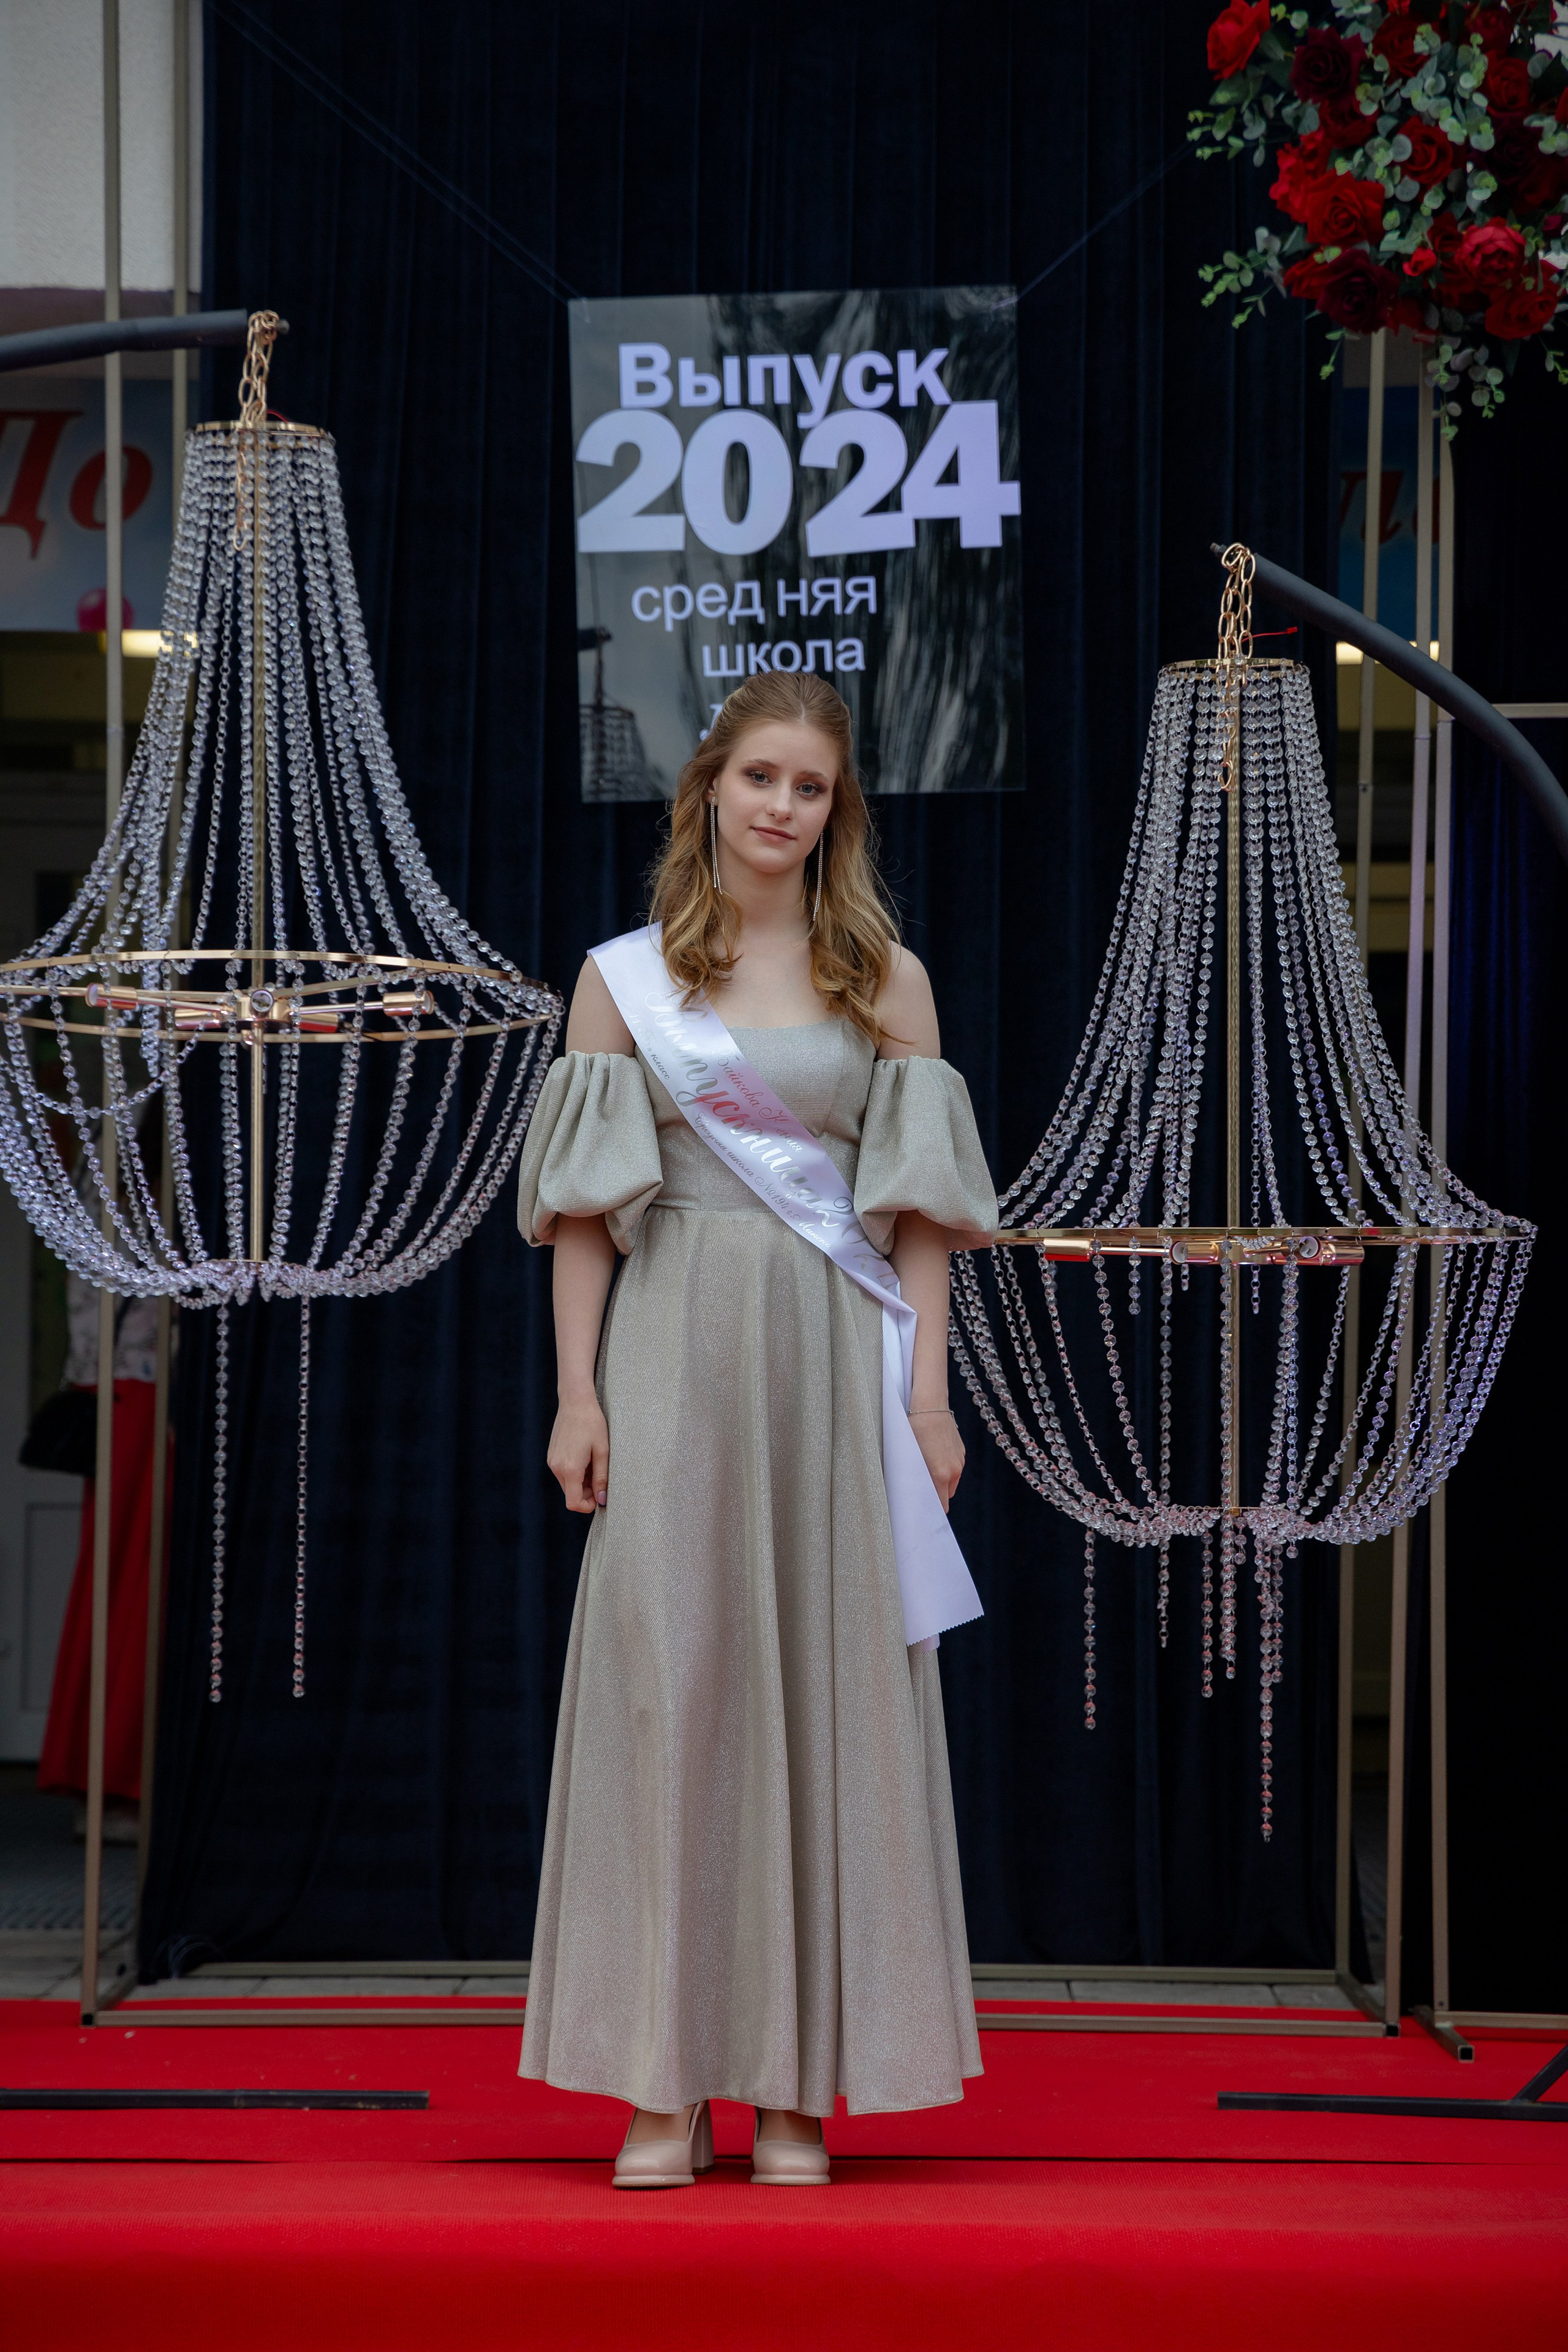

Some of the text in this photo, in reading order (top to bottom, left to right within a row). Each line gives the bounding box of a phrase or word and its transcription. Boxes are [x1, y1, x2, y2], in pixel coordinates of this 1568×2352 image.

[619, 342, 952, 428] Выпуск
[575, 399, 1022, 557] 2024
[702, 637, 866, 677] школа
[650, 1054, 670, 1080] класс
[727, 1151, 753, 1177] школа
[755, 1177, 789, 1209] №194
